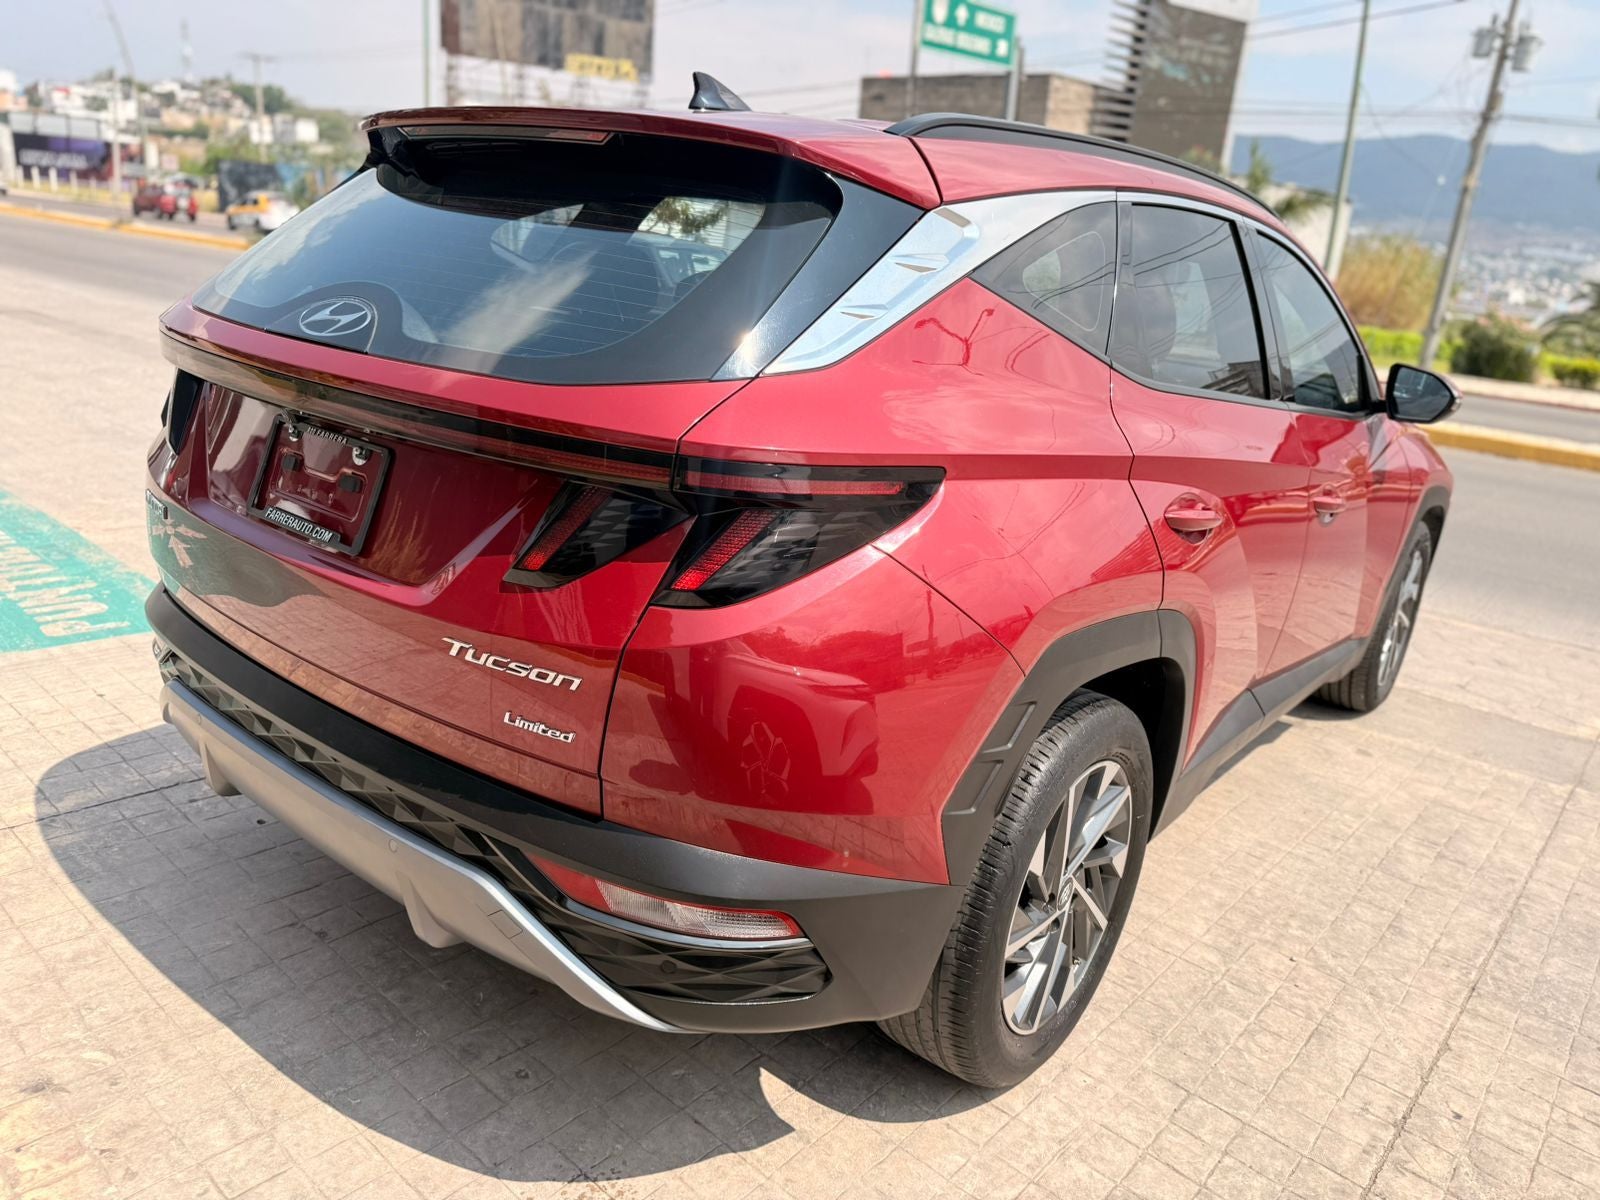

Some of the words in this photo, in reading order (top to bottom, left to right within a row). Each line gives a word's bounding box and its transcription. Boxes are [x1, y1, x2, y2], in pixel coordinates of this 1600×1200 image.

[264, 507, 333, 543] FARRERAUTO.COM
[441, 637, 583, 691] Tucson
[503, 711, 577, 743] Limited
